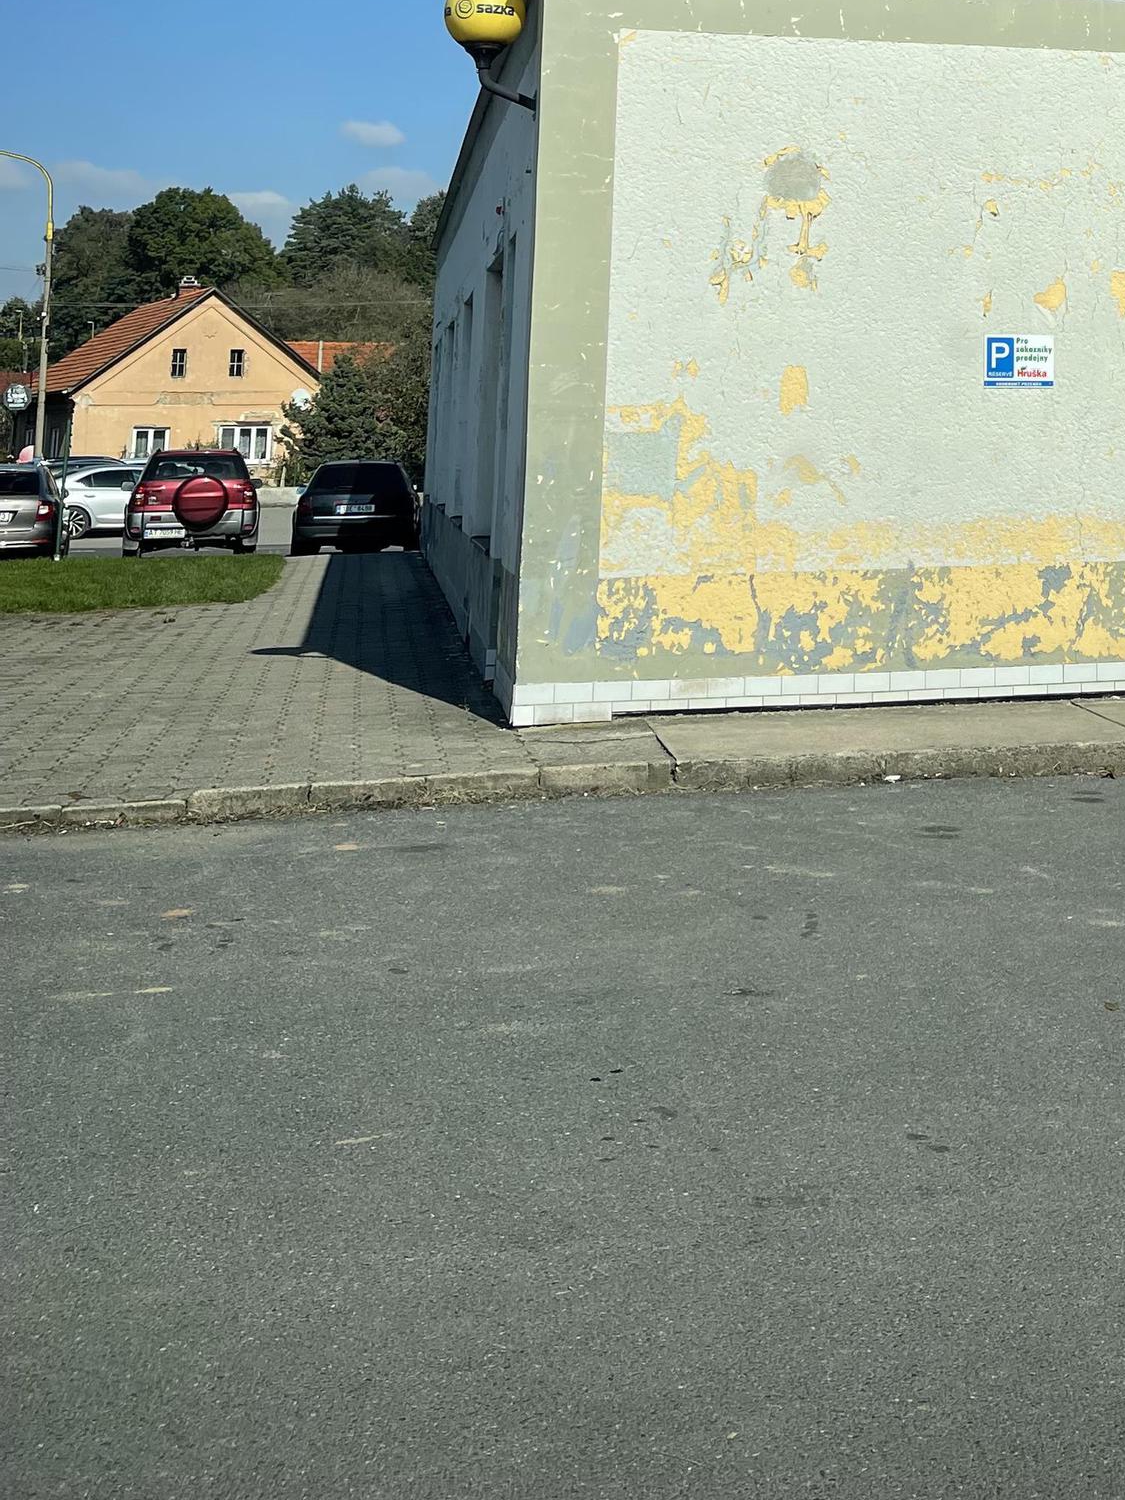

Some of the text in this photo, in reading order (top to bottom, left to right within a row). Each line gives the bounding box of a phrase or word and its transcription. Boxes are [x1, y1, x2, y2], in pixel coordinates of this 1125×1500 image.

[476, 4, 515, 16] sazka
[991, 342, 1010, 369] P
[1017, 369, 1047, 378] Hruška
